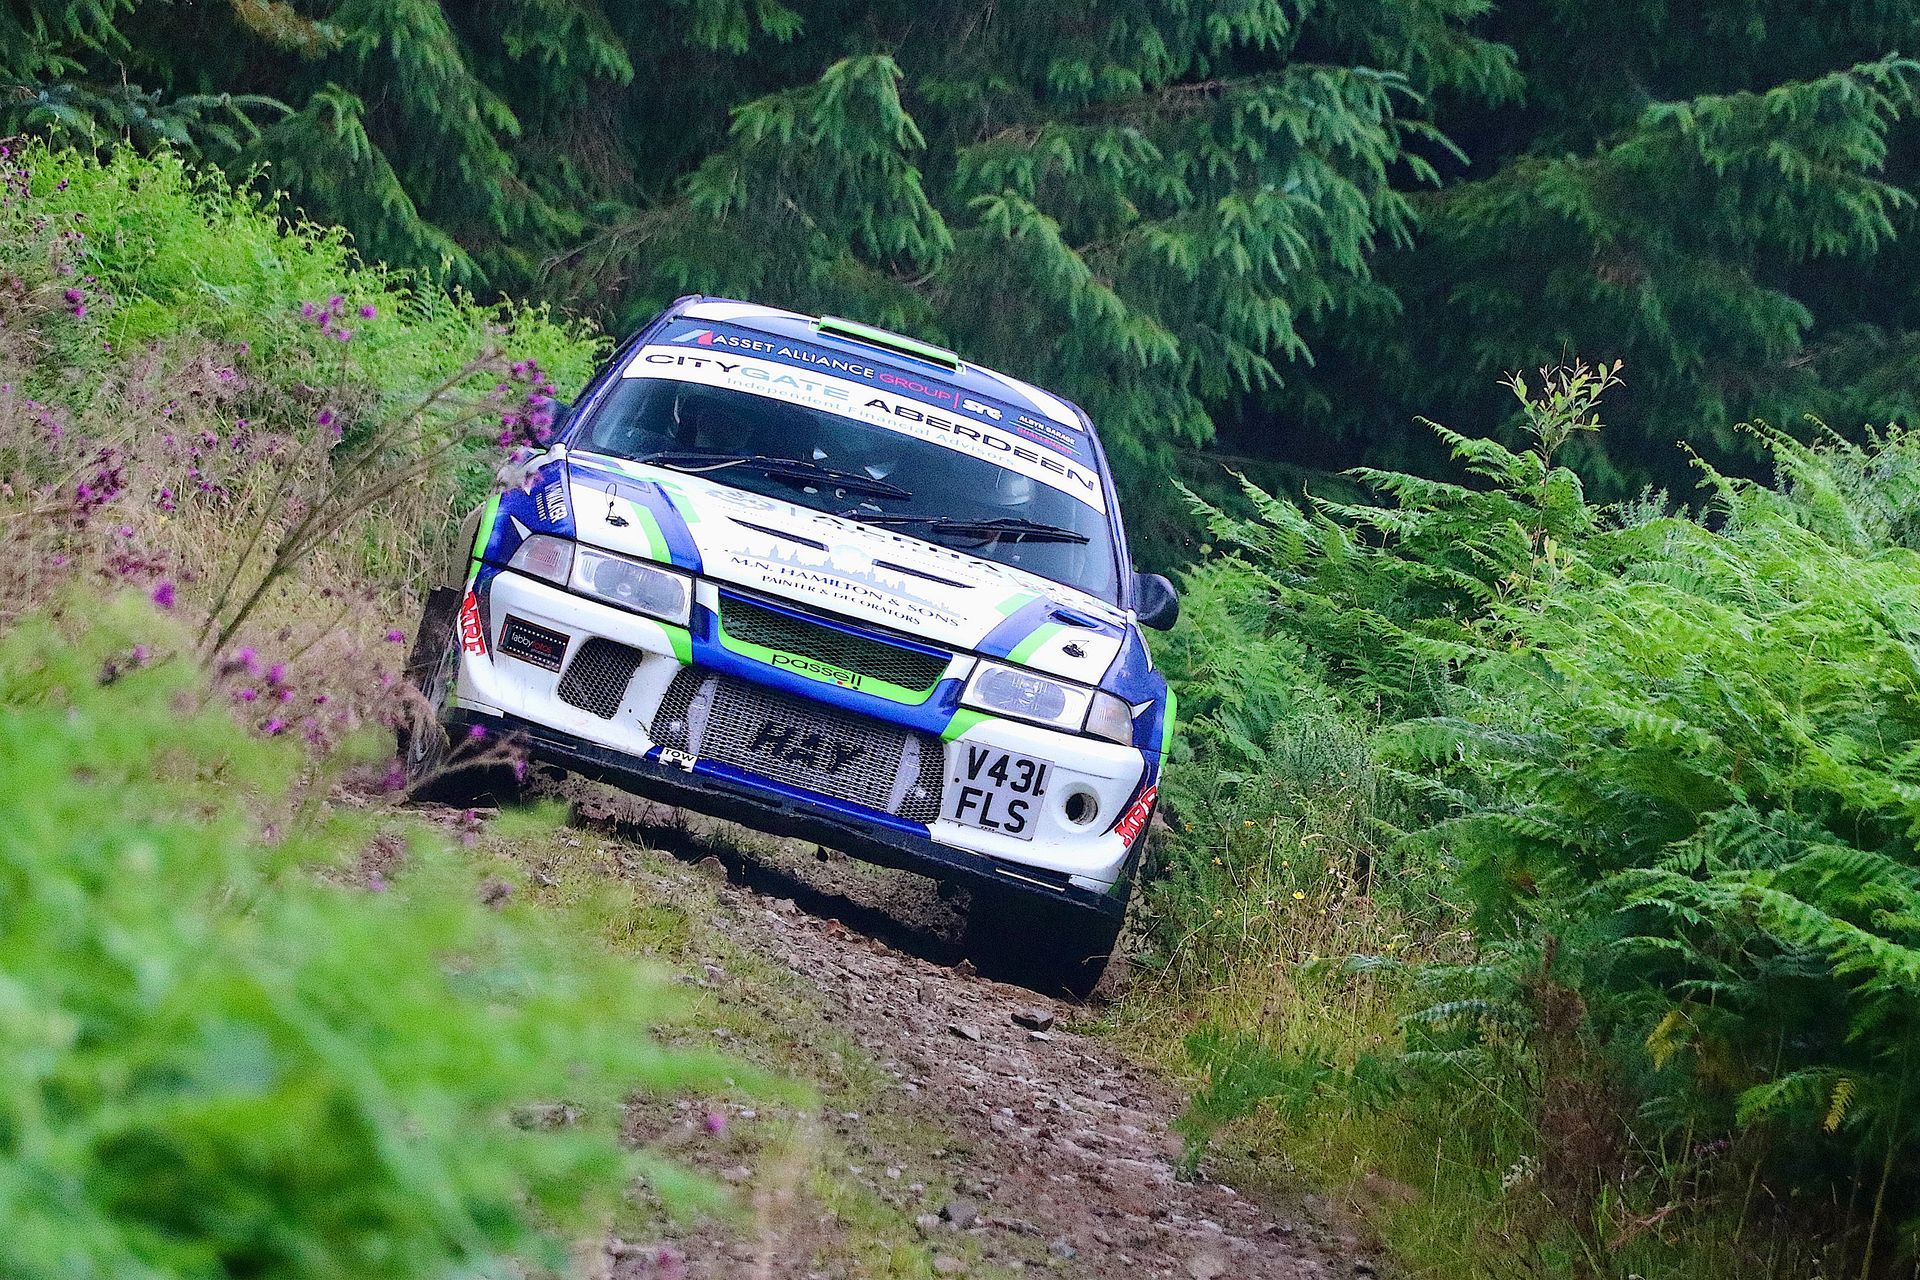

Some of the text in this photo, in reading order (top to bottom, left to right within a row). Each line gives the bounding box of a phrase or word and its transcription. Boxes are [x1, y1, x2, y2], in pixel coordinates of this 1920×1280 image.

[713, 334, 952, 400] ASSET ALLIANCE GROUP
[727, 377, 1016, 467] Independent Financial Advisors
[864, 399, 1095, 491] ABERDEEN
[762, 575, 817, 594] PAINTER
[834, 592, 921, 626] DECORATORS
[780, 566, 885, 601] HAMILTON
[460, 590, 486, 656] MRF
[771, 653, 862, 688] passell
[664, 748, 696, 763] TOW
[752, 720, 861, 774] HAY
[955, 786, 1030, 834] FLS
